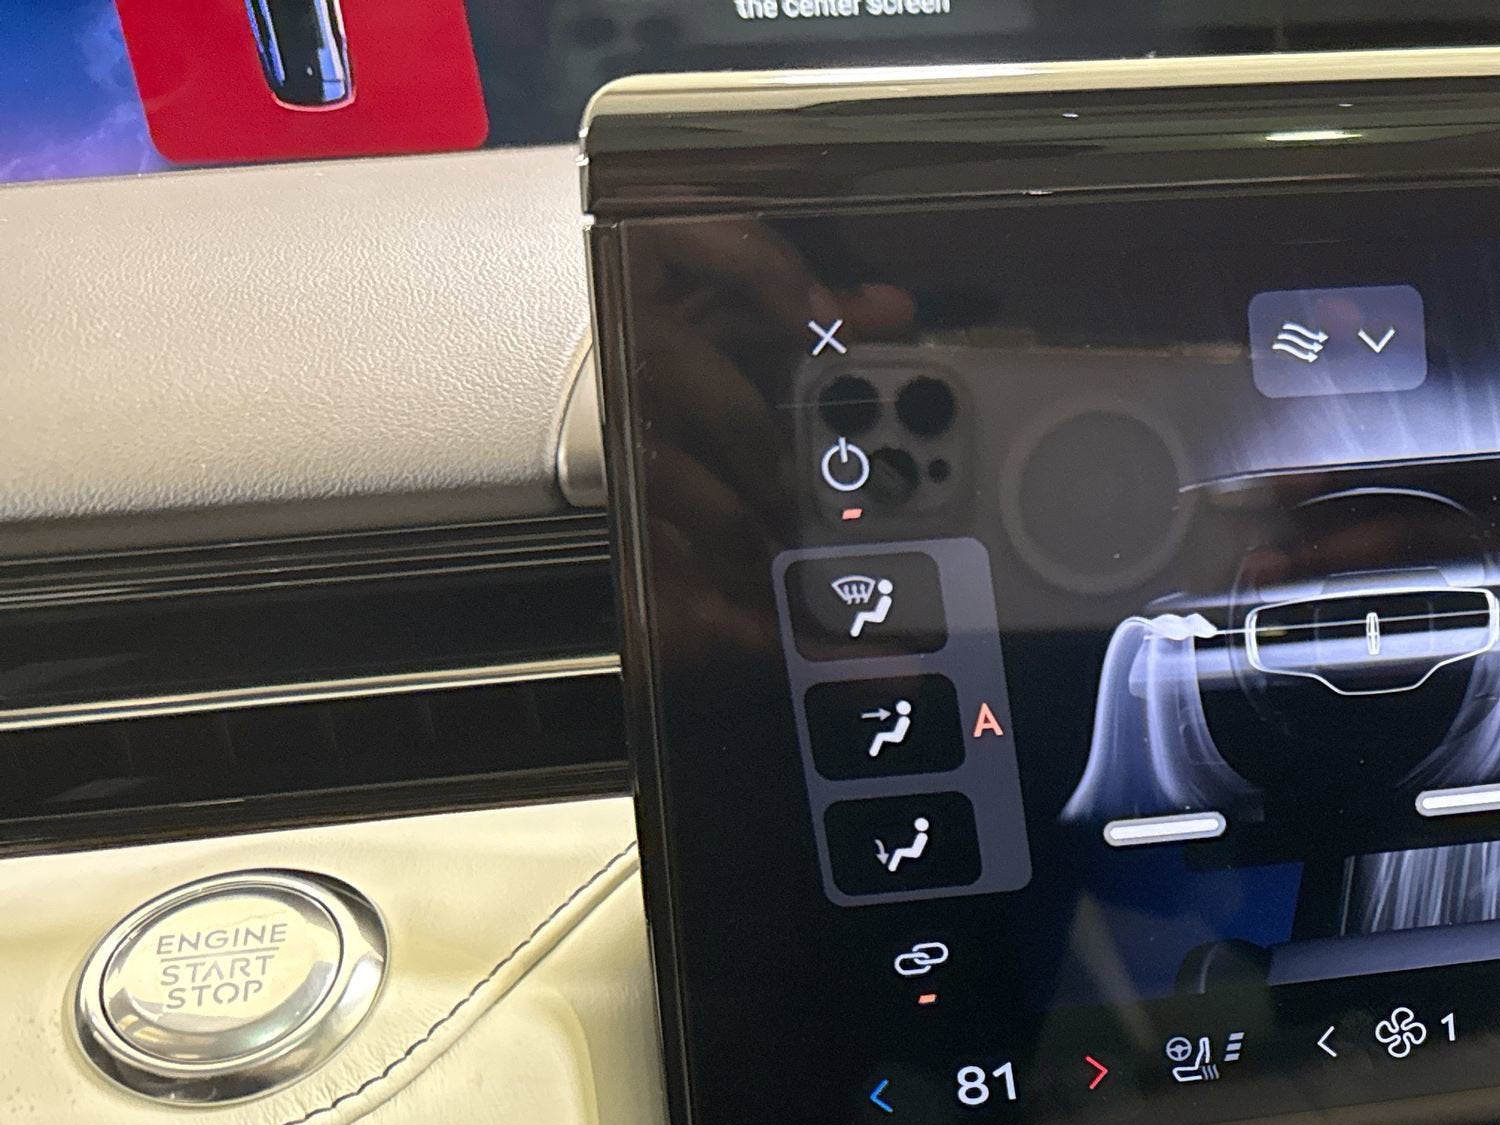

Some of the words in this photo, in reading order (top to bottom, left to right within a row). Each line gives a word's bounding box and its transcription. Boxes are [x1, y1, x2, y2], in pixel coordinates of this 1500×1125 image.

[735, 0, 779, 19] the
[782, 0, 861, 18] center
[865, 0, 950, 15] screen
[973, 702, 1004, 738] A
[156, 923, 288, 955] ENGINE
[161, 955, 275, 986] START
[166, 980, 263, 1010] STOP
[1440, 1012, 1456, 1042] 1
[956, 1061, 1017, 1106] 81
